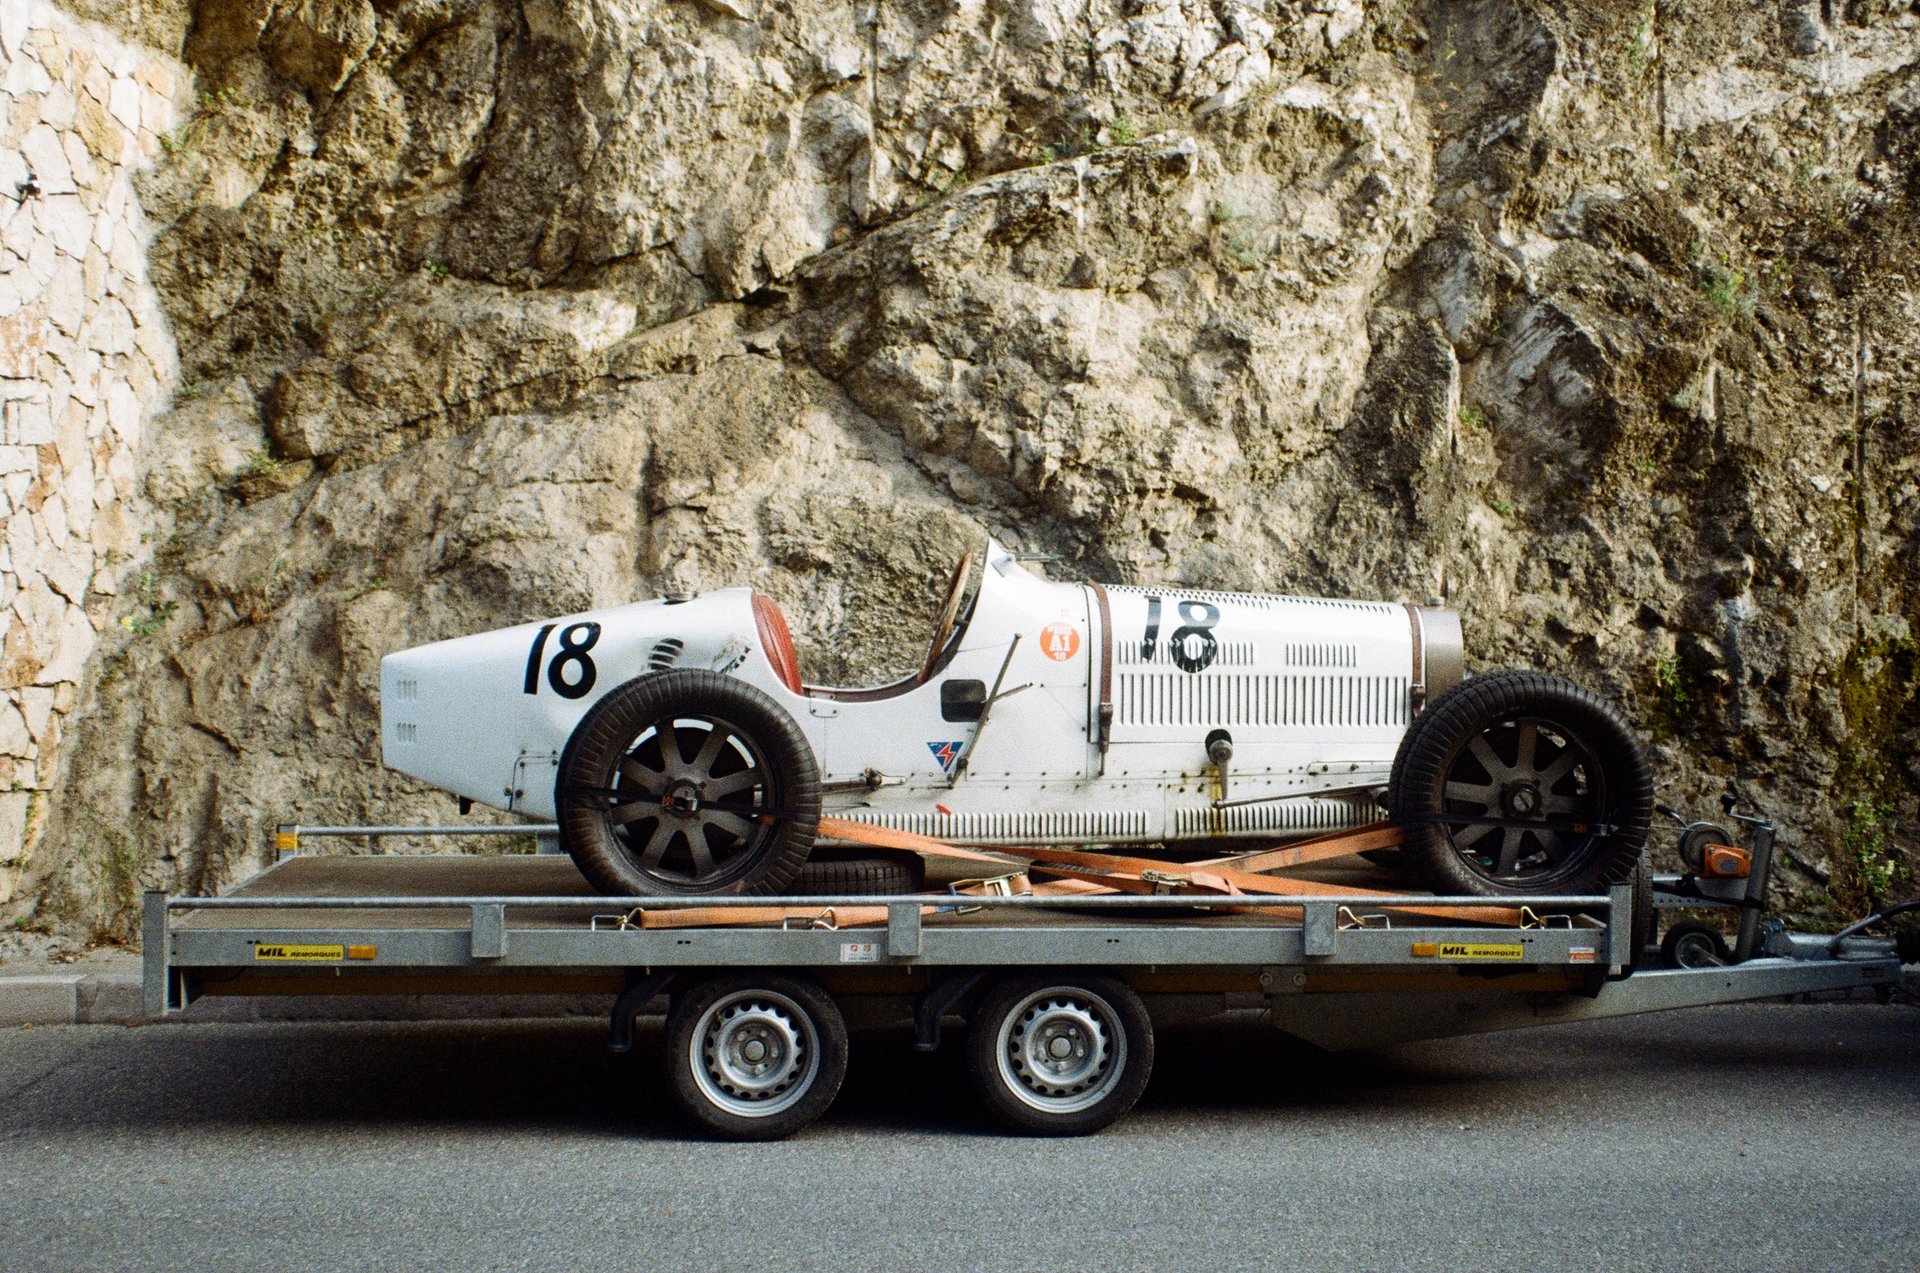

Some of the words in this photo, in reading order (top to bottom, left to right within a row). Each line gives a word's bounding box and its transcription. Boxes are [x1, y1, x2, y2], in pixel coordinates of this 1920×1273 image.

[1142, 595, 1220, 673] 18
[523, 622, 602, 700] 18
[258, 948, 287, 957] MIL
[1442, 946, 1468, 956] MIL
